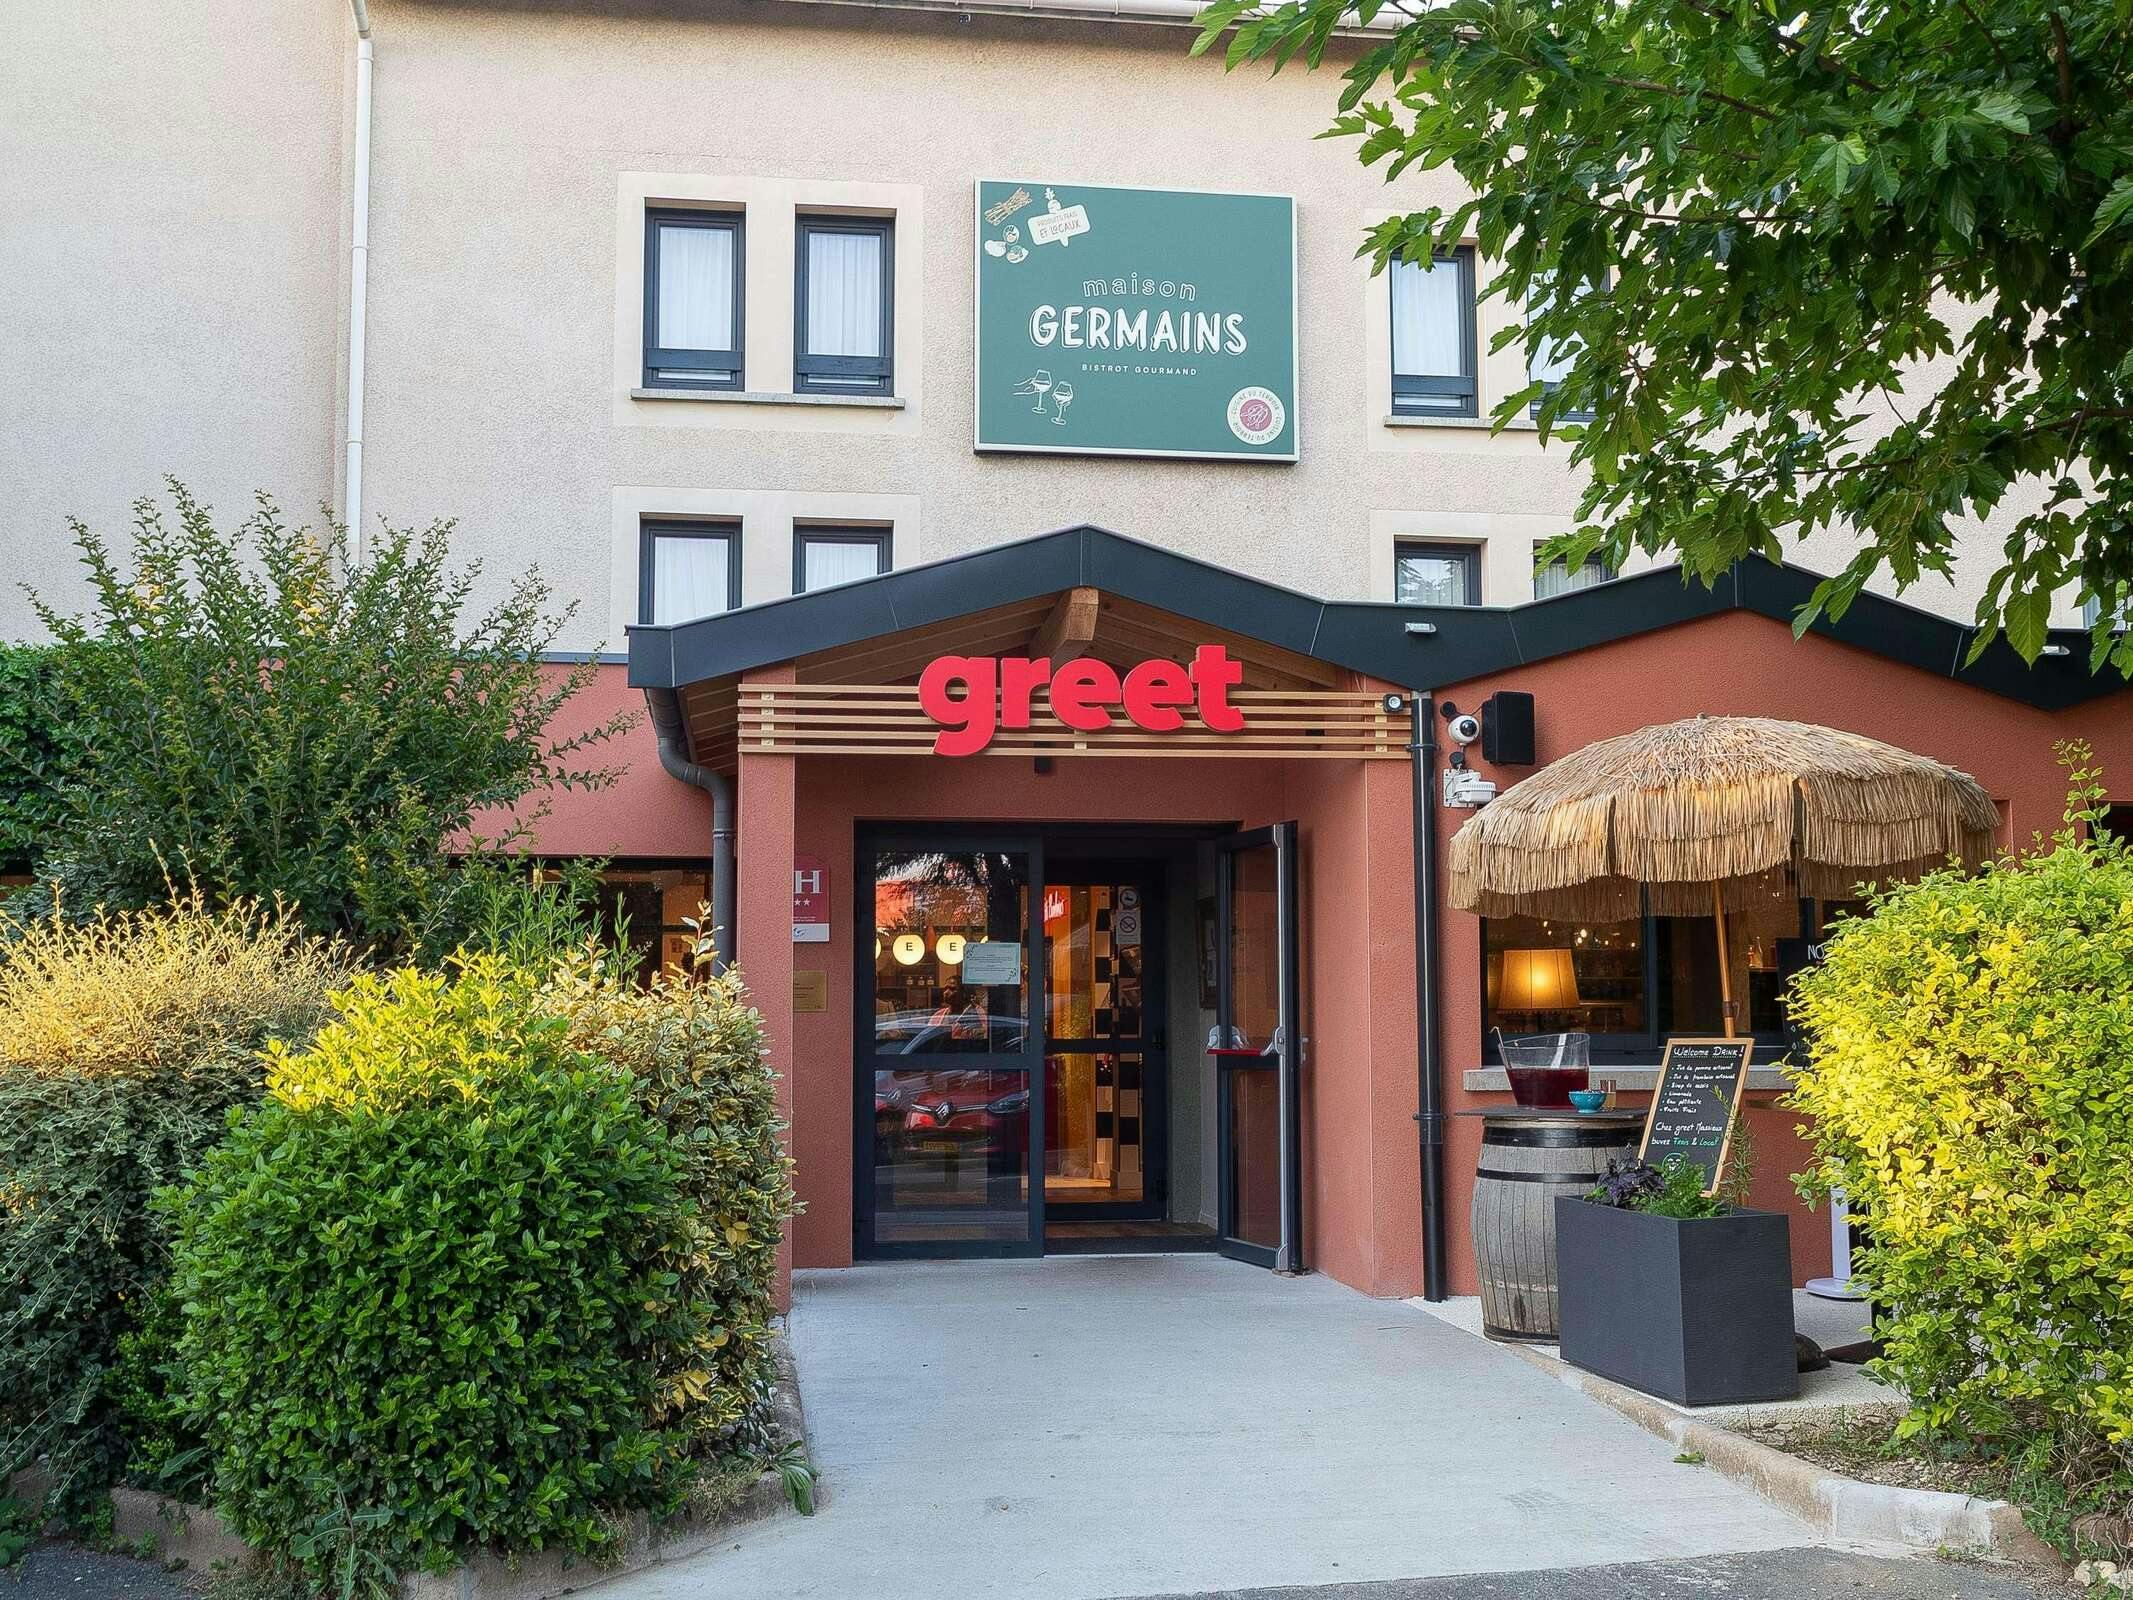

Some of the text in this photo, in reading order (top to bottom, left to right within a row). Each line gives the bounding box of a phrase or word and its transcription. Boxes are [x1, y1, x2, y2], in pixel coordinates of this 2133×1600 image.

[1040, 227, 1048, 238] ET
[1082, 272, 1196, 301] maison
[1028, 304, 1248, 355] GERMAINS
[1081, 363, 1197, 376] BISTROT GOURMAND
[918, 644, 1246, 756] greet
[794, 869, 823, 894] H
[906, 942, 957, 951] E E
[1673, 1046, 1709, 1056] Welcome
[1655, 1121, 1672, 1131] Chez
[1674, 1123, 1694, 1136] greet
[1651, 1136, 1671, 1145] buvez
